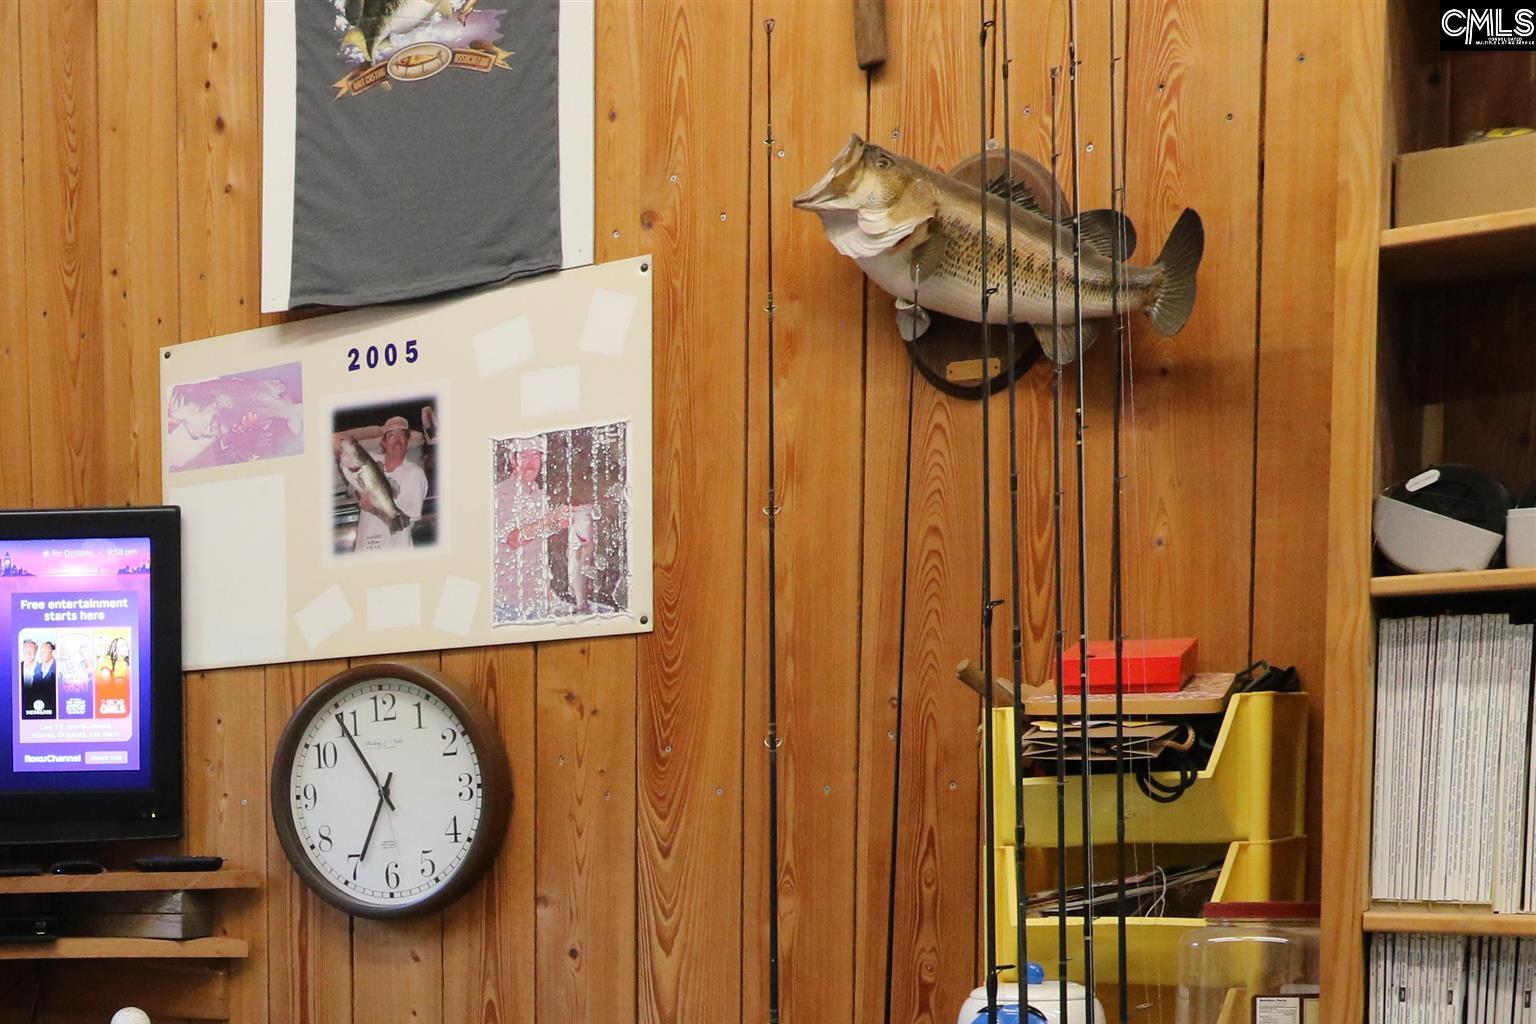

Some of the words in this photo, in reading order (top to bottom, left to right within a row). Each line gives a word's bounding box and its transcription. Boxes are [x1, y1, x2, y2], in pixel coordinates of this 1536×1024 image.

[348, 340, 418, 372] 2005
[20, 600, 45, 610] Free
[48, 598, 128, 609] entertainment
[44, 611, 77, 621] starts
[80, 610, 105, 620] here
[370, 693, 397, 722] 12
[413, 701, 425, 729] 1
[338, 710, 361, 738] 11
[315, 741, 338, 769] 10
[441, 728, 458, 757] 2
[303, 783, 317, 810] 9
[458, 773, 474, 801] 3
[318, 825, 333, 851] 8
[445, 815, 462, 843] 4
[347, 853, 361, 881] 7
[385, 861, 399, 889] 6
[420, 850, 436, 877] 5
